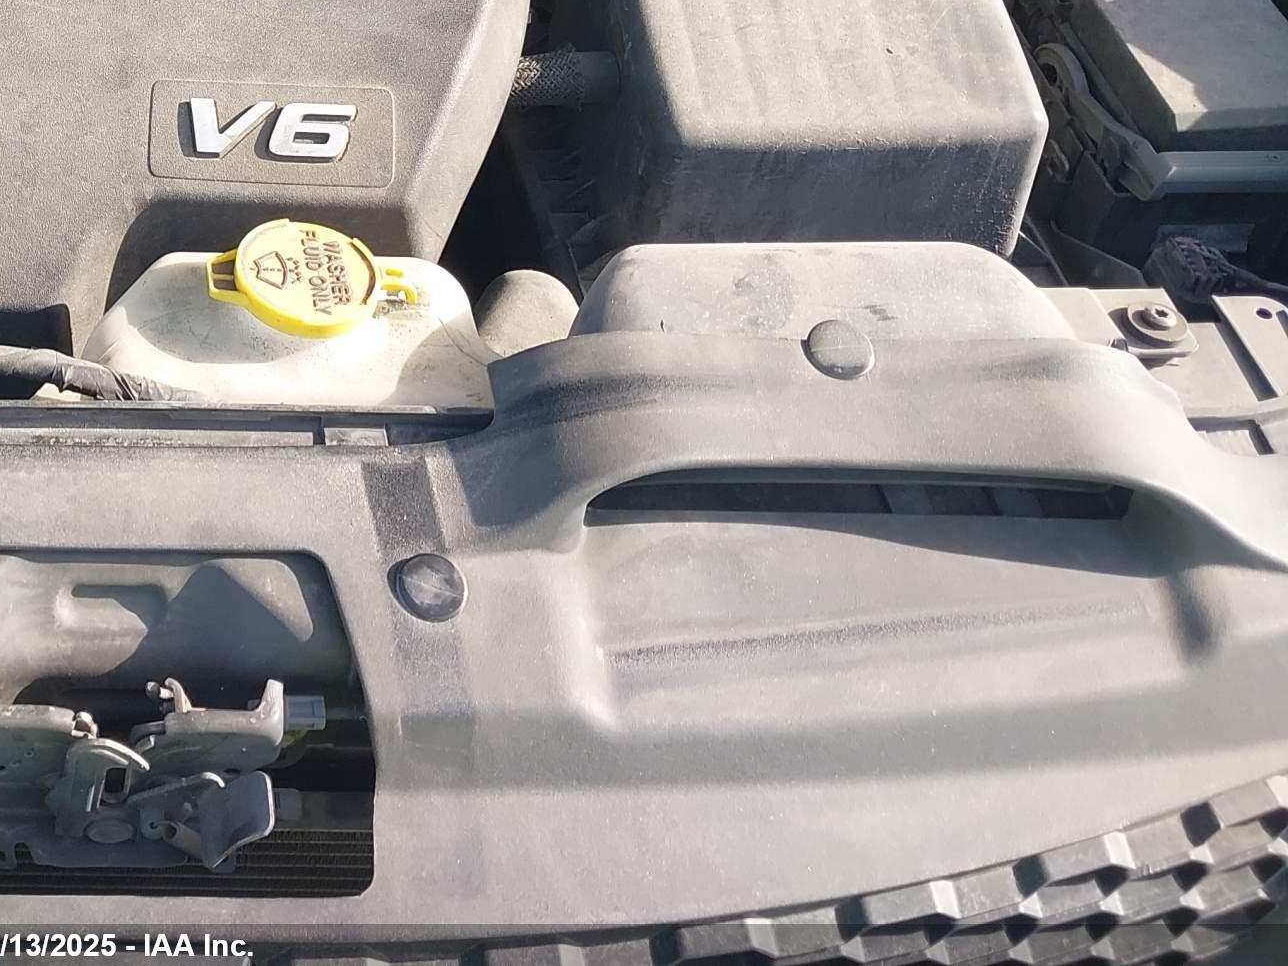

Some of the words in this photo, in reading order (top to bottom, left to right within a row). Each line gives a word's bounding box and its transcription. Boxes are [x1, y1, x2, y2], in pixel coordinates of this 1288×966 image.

[189, 97, 358, 160] V6
[299, 229, 322, 272] FLUID
[322, 240, 351, 306] WASHER
[308, 275, 333, 316] ONLY
